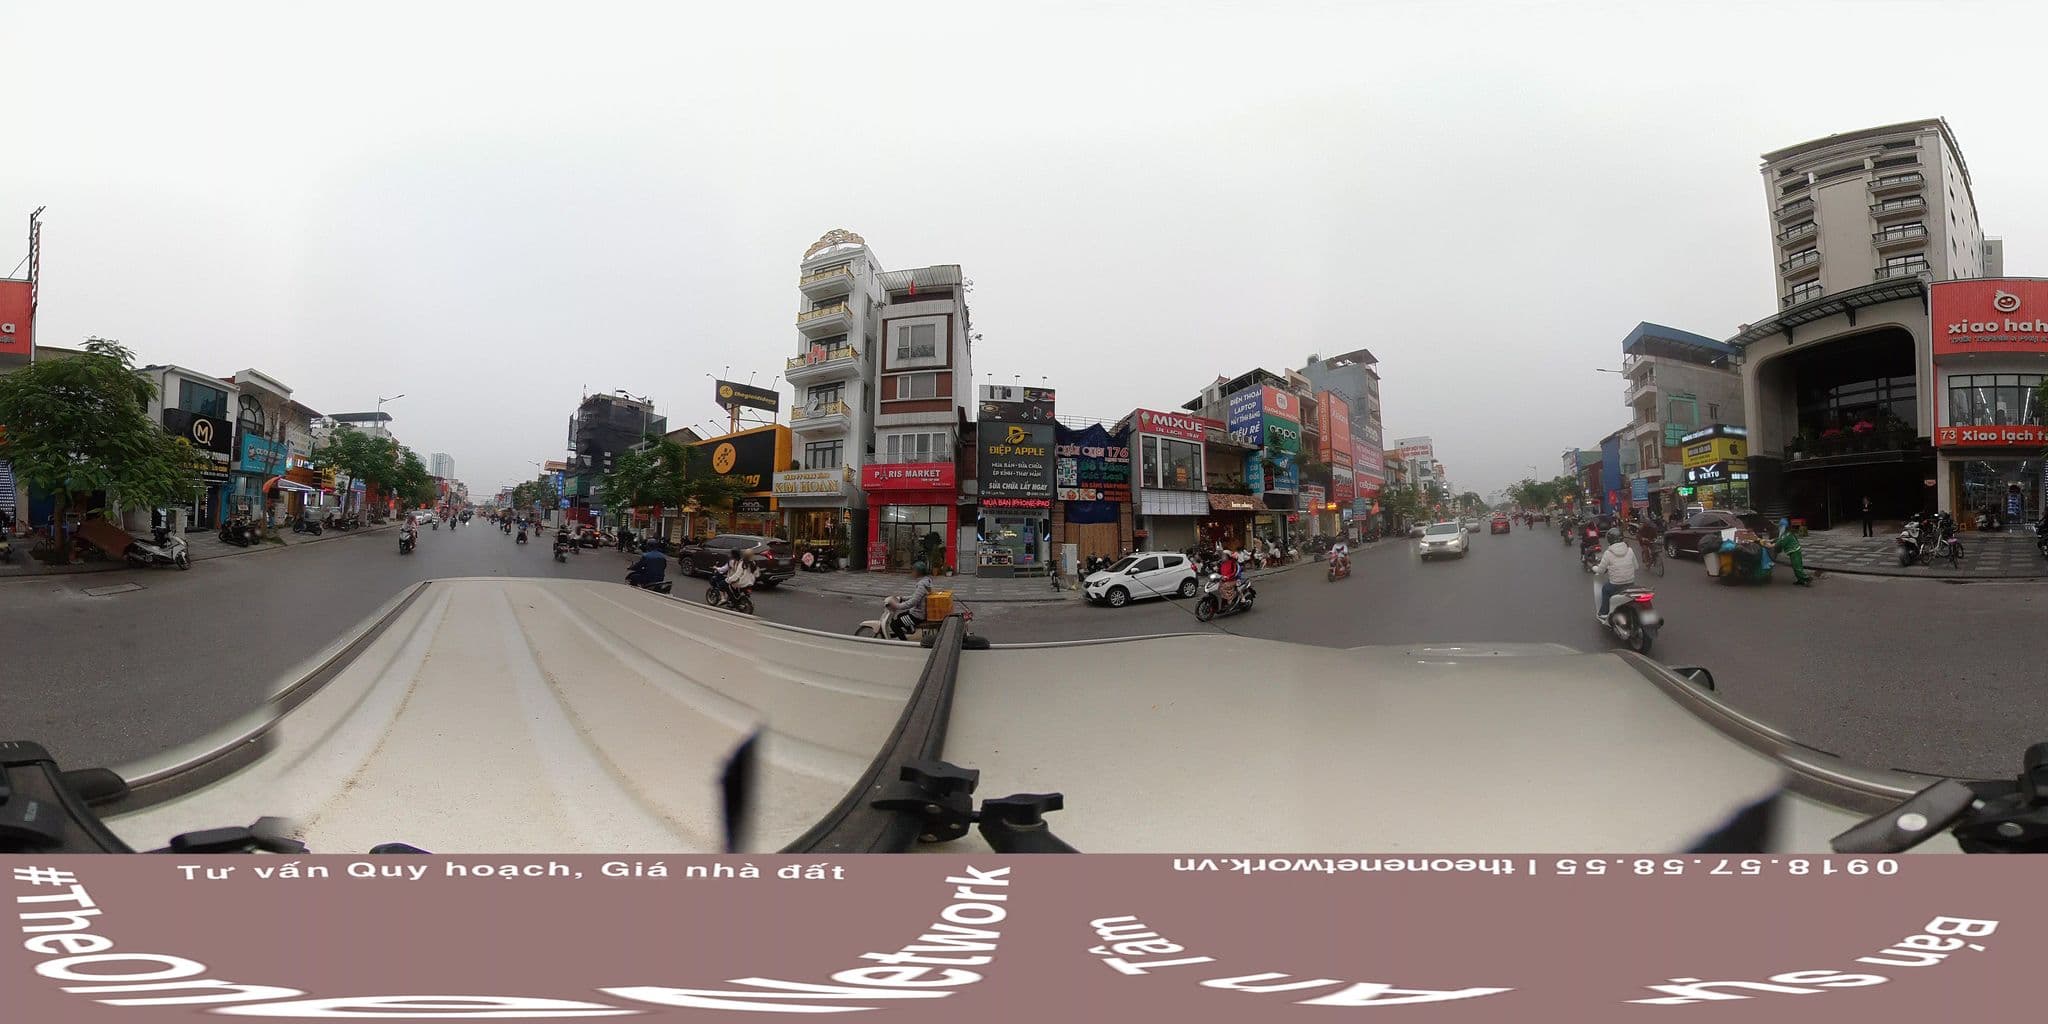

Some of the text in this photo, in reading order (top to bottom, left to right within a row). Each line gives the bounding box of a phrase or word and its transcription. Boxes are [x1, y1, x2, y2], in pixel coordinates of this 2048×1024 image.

[1948, 319, 1999, 334] xiao
[1234, 402, 1257, 414] LAPTOP
[1153, 414, 1203, 433] MIXUE
[1940, 430, 1956, 440] 73
[1962, 430, 1997, 440] Xiao
[2001, 430, 2033, 443] lạch
[1015, 447, 1045, 456] APPLE
[1107, 446, 1129, 457] 176
[1699, 471, 1719, 479] VERTU
